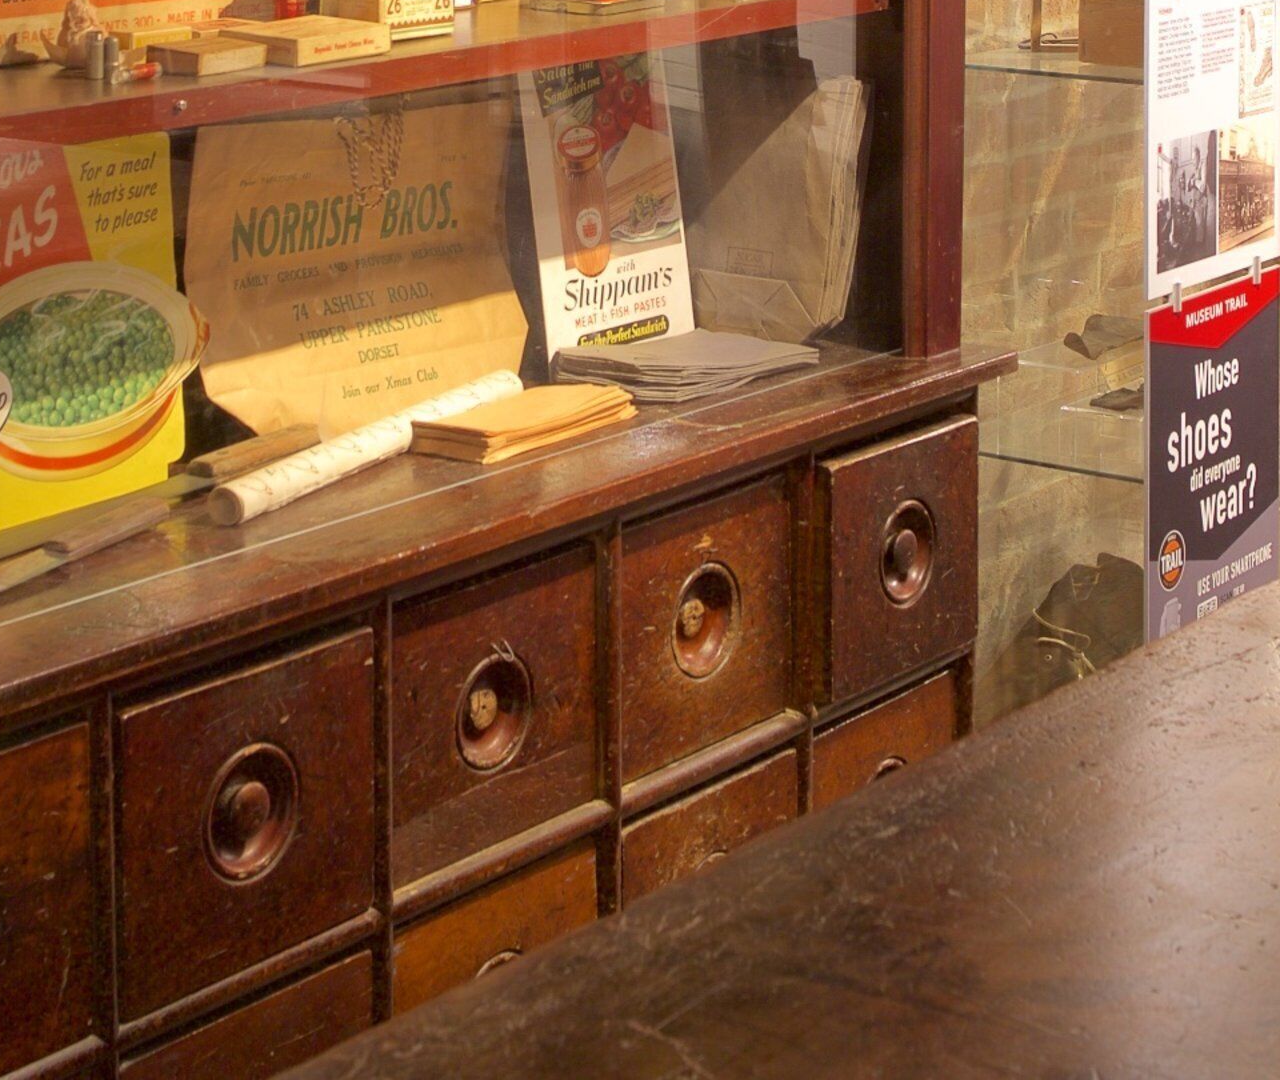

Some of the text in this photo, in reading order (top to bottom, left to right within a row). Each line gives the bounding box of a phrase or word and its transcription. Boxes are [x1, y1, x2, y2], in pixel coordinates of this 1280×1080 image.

[168, 9, 213, 23] MADE IN
[538, 62, 575, 84] Salad
[543, 81, 587, 108] Sandwich
[79, 151, 156, 182] For a meal
[87, 180, 158, 207] that's sure
[95, 206, 159, 233] to please
[231, 181, 458, 262] NORRISH BROS.
[233, 243, 465, 291] FAMILY GROCERS AND PROVISION MERCHANTS
[616, 259, 636, 274] with
[292, 281, 433, 321] 74 ASHLEY ROAD,
[564, 267, 673, 312] Shippam's
[575, 296, 667, 329] MEAT & FISH PASTES
[1185, 293, 1248, 328] MUSEUM TRAIL
[299, 306, 442, 349] UPPER PARKSTONE
[579, 317, 667, 346] For the Perfect Sandwich
[358, 343, 400, 364] DORSET
[342, 367, 439, 399] Join our Xmas Club
[1194, 358, 1240, 400] Whose
[1167, 407, 1232, 473] shoes
[1190, 454, 1241, 493] did everyone
[1200, 463, 1257, 533] wear?
[1160, 548, 1183, 575] TRAIL
[1197, 542, 1272, 596] USE YOUR SMARTPHONE
